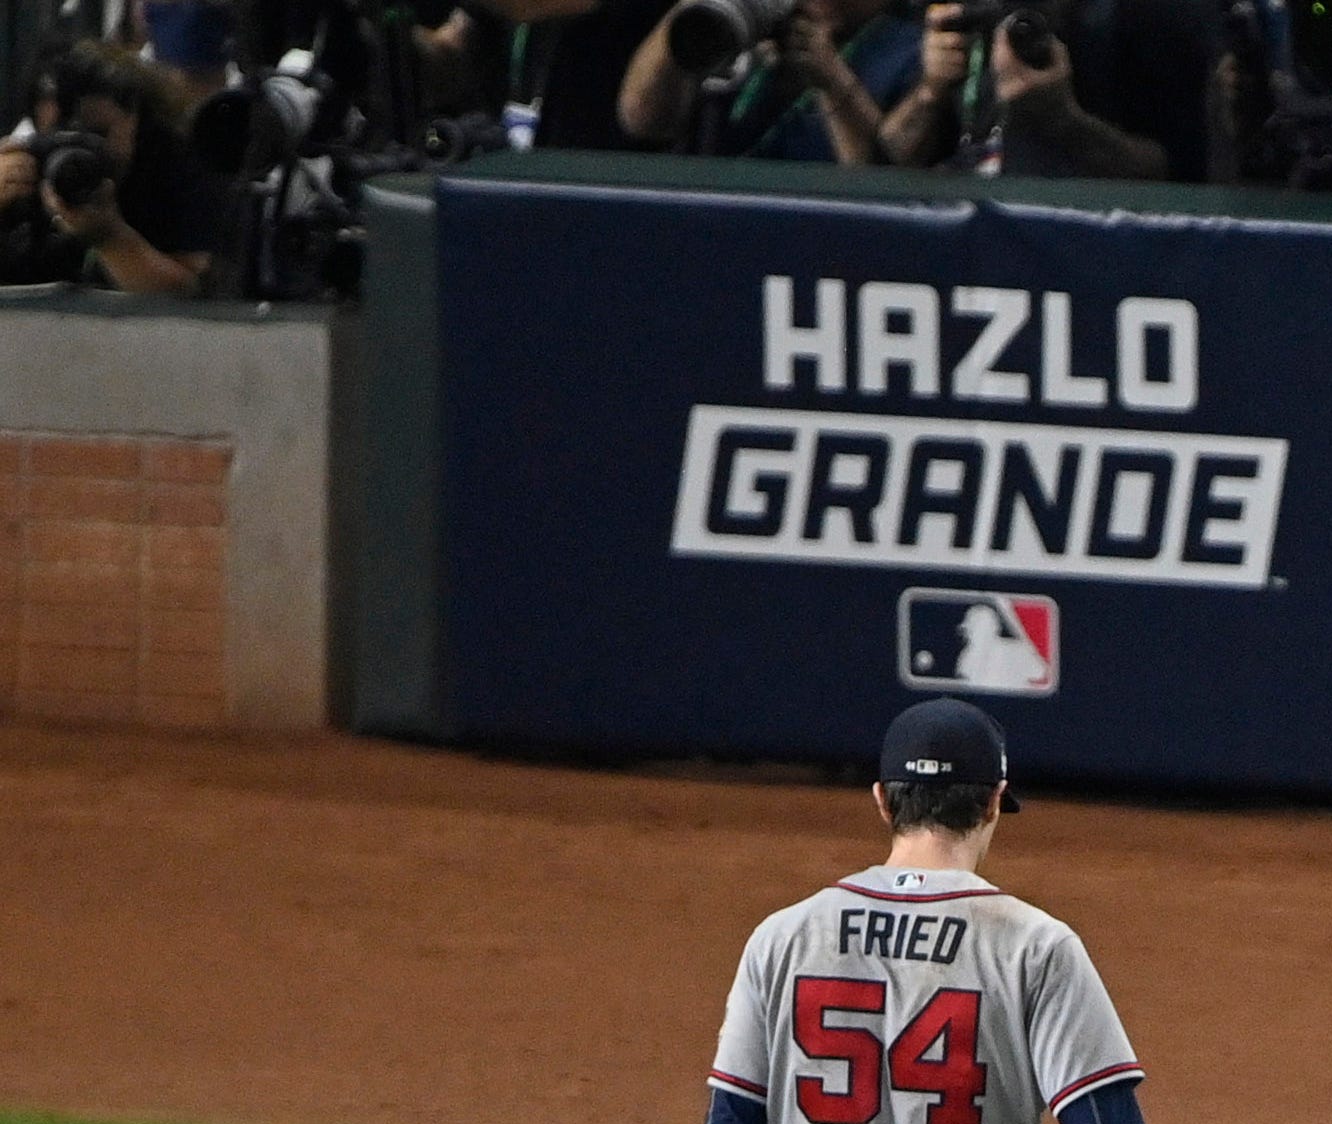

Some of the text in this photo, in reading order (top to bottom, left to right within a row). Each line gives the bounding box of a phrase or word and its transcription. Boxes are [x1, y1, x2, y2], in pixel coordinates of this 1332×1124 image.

[762, 274, 1198, 412] HAZLO
[706, 425, 1263, 566] GRANDE
[839, 908, 967, 965] FRIED
